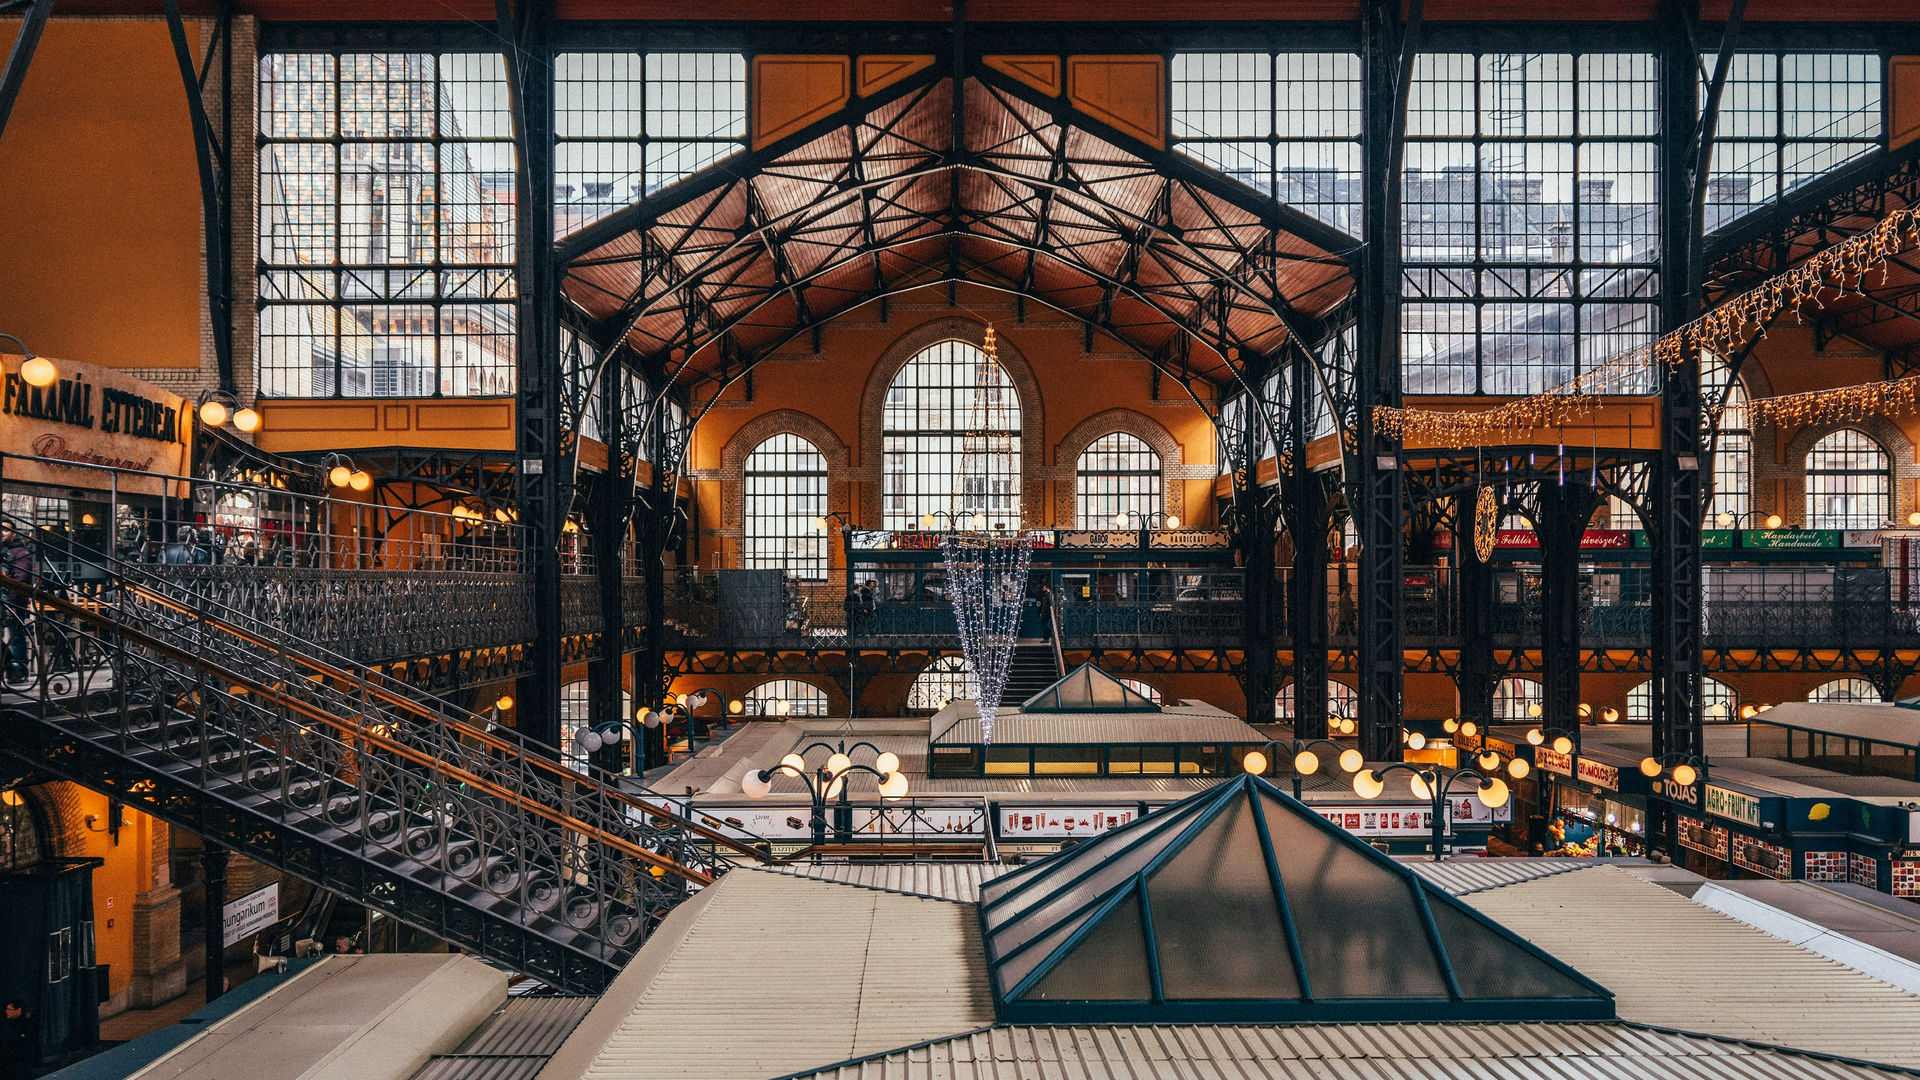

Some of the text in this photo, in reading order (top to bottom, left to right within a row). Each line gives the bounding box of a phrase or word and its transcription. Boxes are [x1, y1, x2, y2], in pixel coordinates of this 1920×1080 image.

[1170, 534, 1207, 543] HANDICRAFT
[1768, 539, 1822, 548] Handmade
[1707, 788, 1746, 820] AGRO-FRUIT
